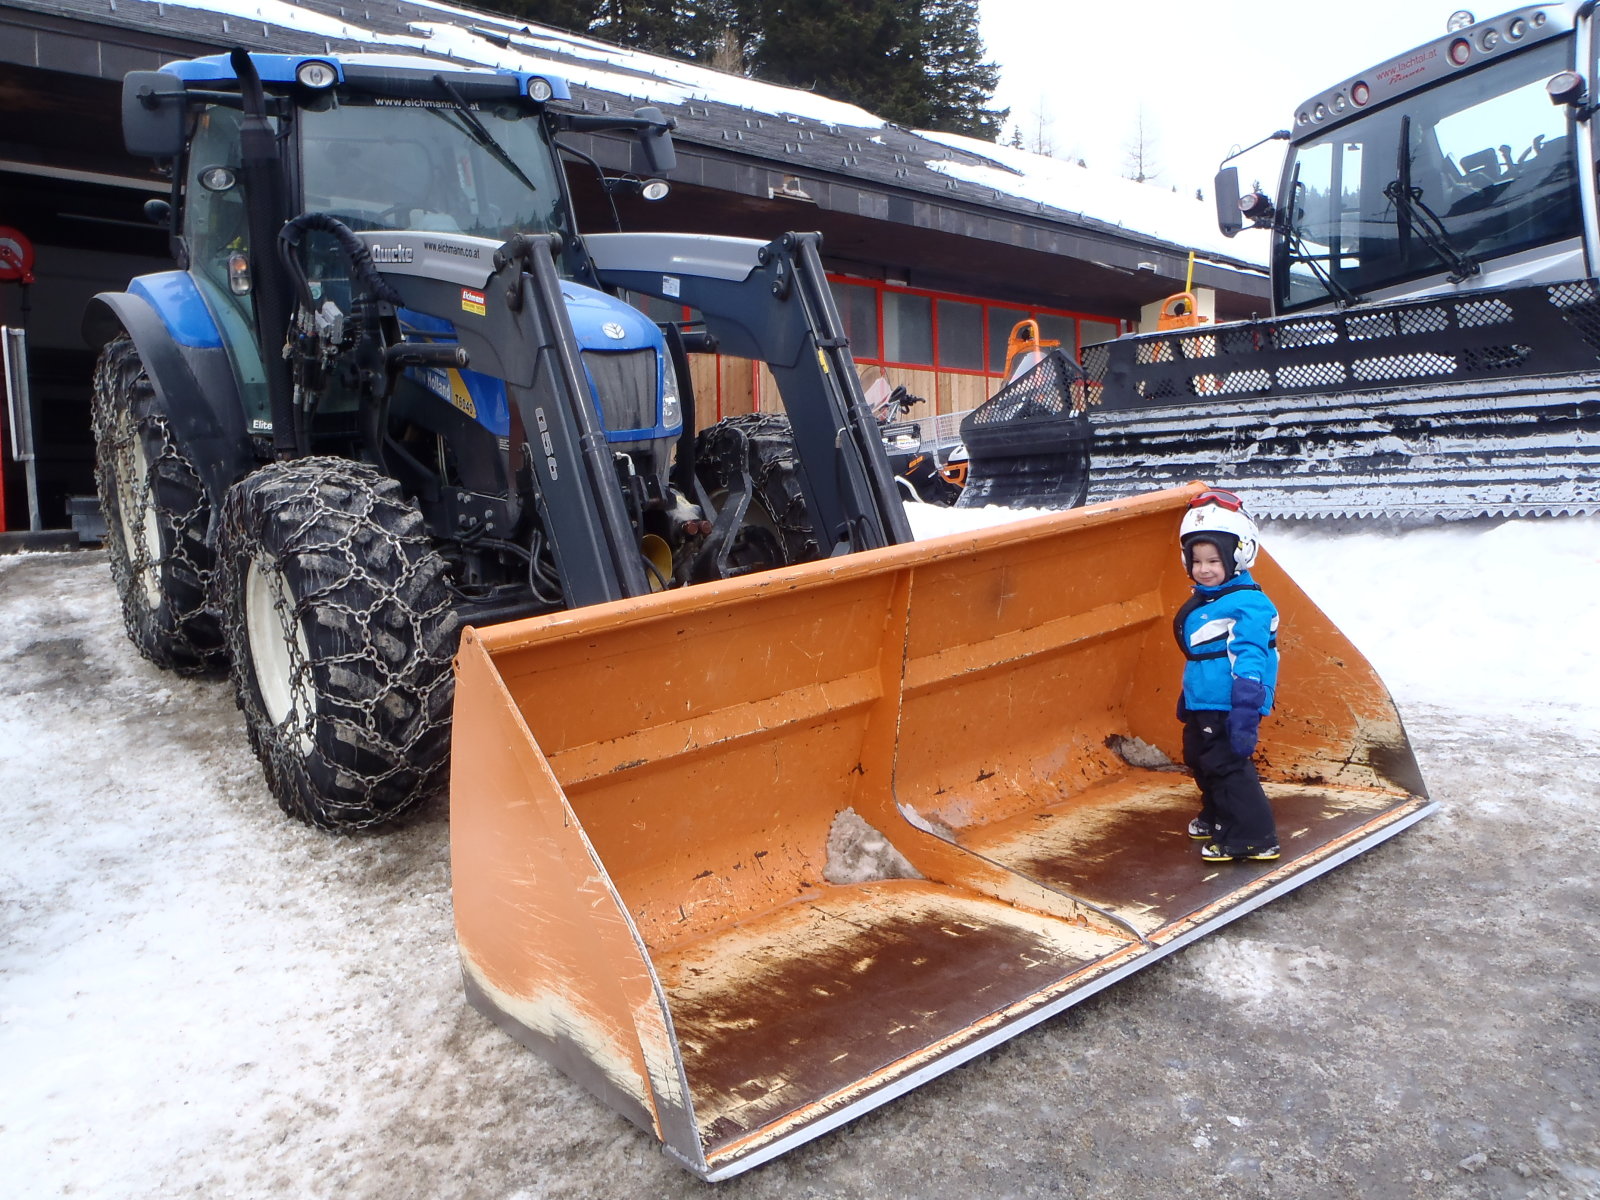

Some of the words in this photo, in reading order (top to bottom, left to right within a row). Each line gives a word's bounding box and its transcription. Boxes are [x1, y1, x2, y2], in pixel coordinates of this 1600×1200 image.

[1376, 49, 1437, 80] www.lachtal.at
[375, 98, 480, 111] www.eichmann.c.at
[372, 244, 413, 263] Quicke
[424, 241, 480, 259] www.eichmann.co.at
[253, 419, 273, 430] Elite
